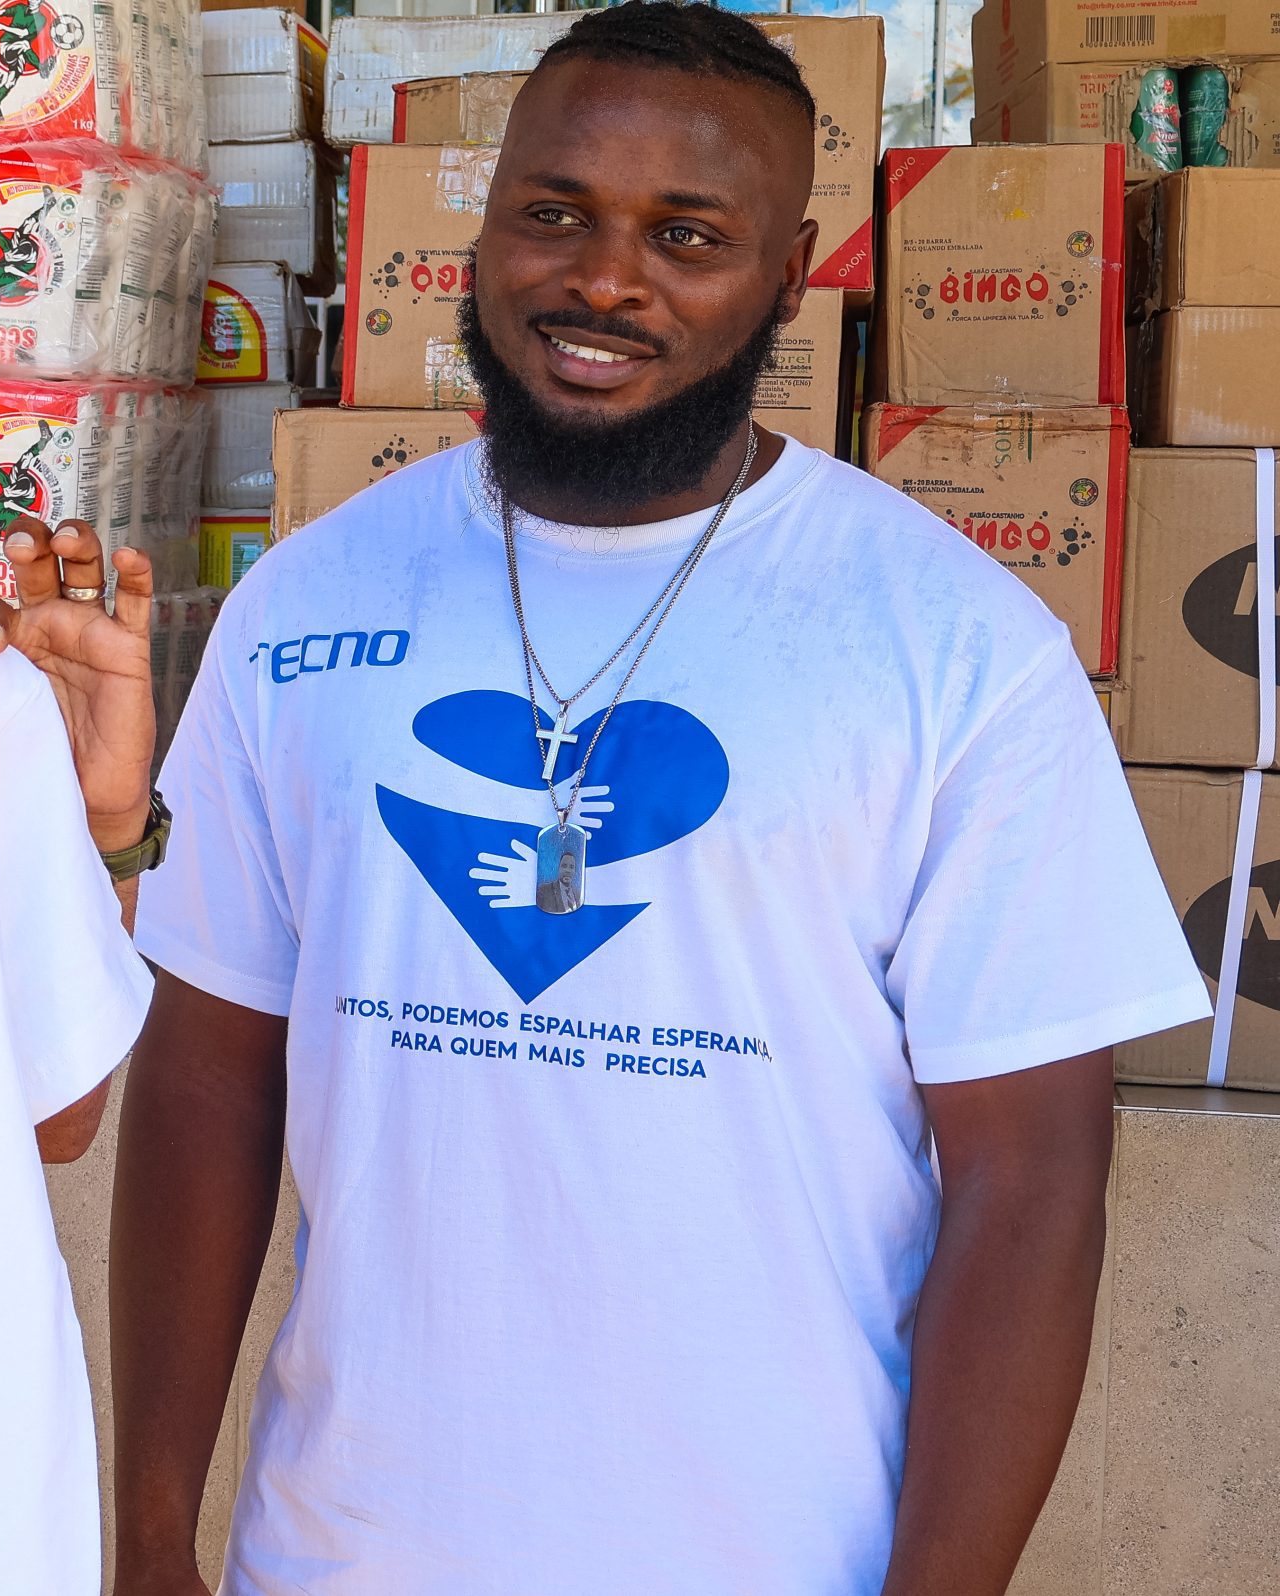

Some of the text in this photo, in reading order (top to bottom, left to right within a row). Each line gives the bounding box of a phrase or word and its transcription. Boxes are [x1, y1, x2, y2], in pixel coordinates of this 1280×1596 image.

[889, 156, 916, 184] NOVO
[838, 250, 867, 278] NOVO
[776, 354, 811, 364] orel
[335, 995, 773, 1063] UNTOS, PODEMOS ESPALHAR ESPERANÇA,
[391, 1030, 708, 1080] PARA QUEM MAIS PRECISA
